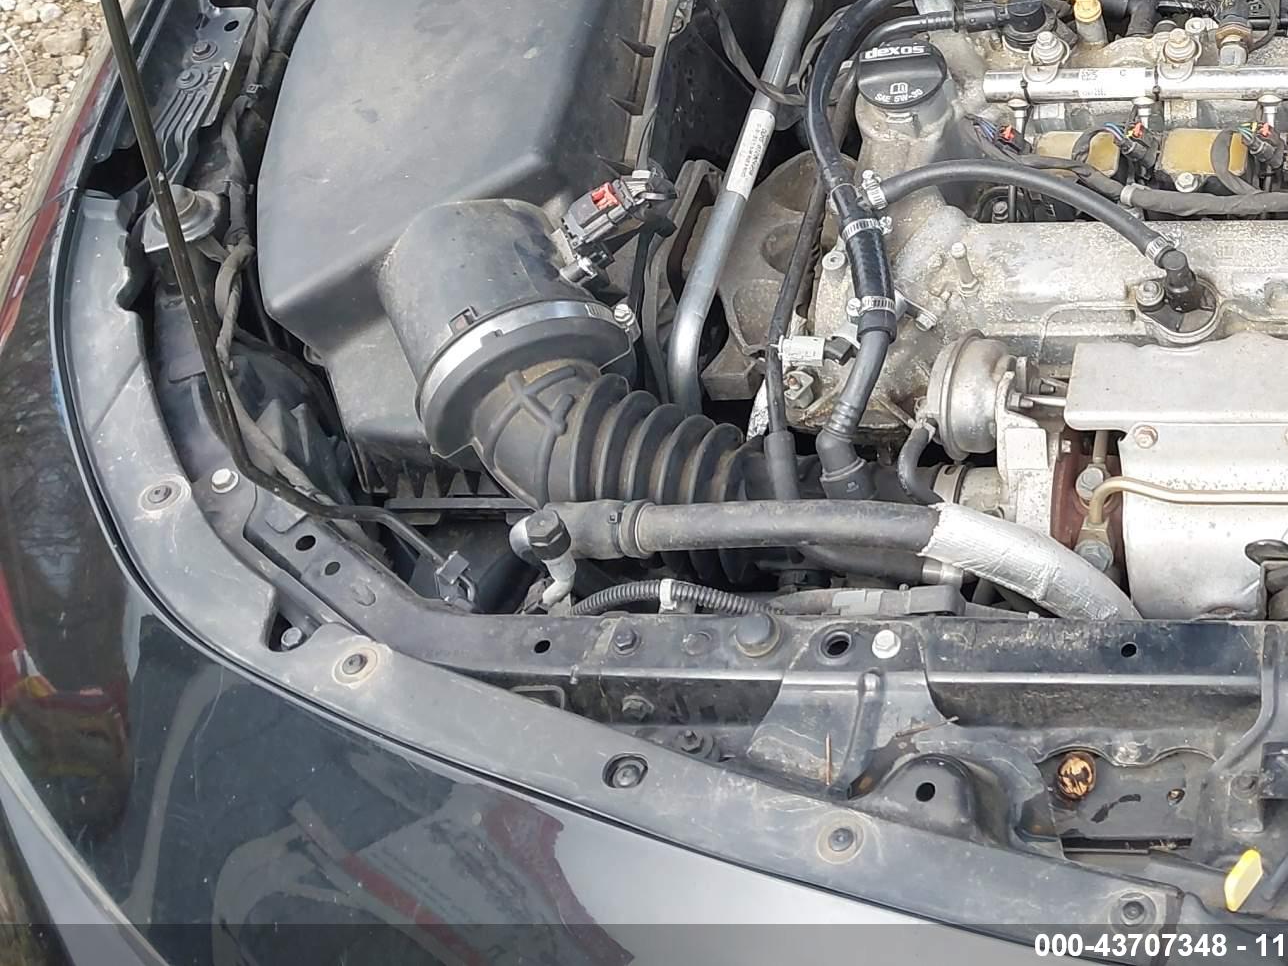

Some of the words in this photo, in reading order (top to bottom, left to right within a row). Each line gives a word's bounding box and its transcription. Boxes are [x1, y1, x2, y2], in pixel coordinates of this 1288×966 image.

[864, 45, 926, 59] dexos
[874, 92, 892, 102] SAE
[893, 88, 924, 102] 5W-30
